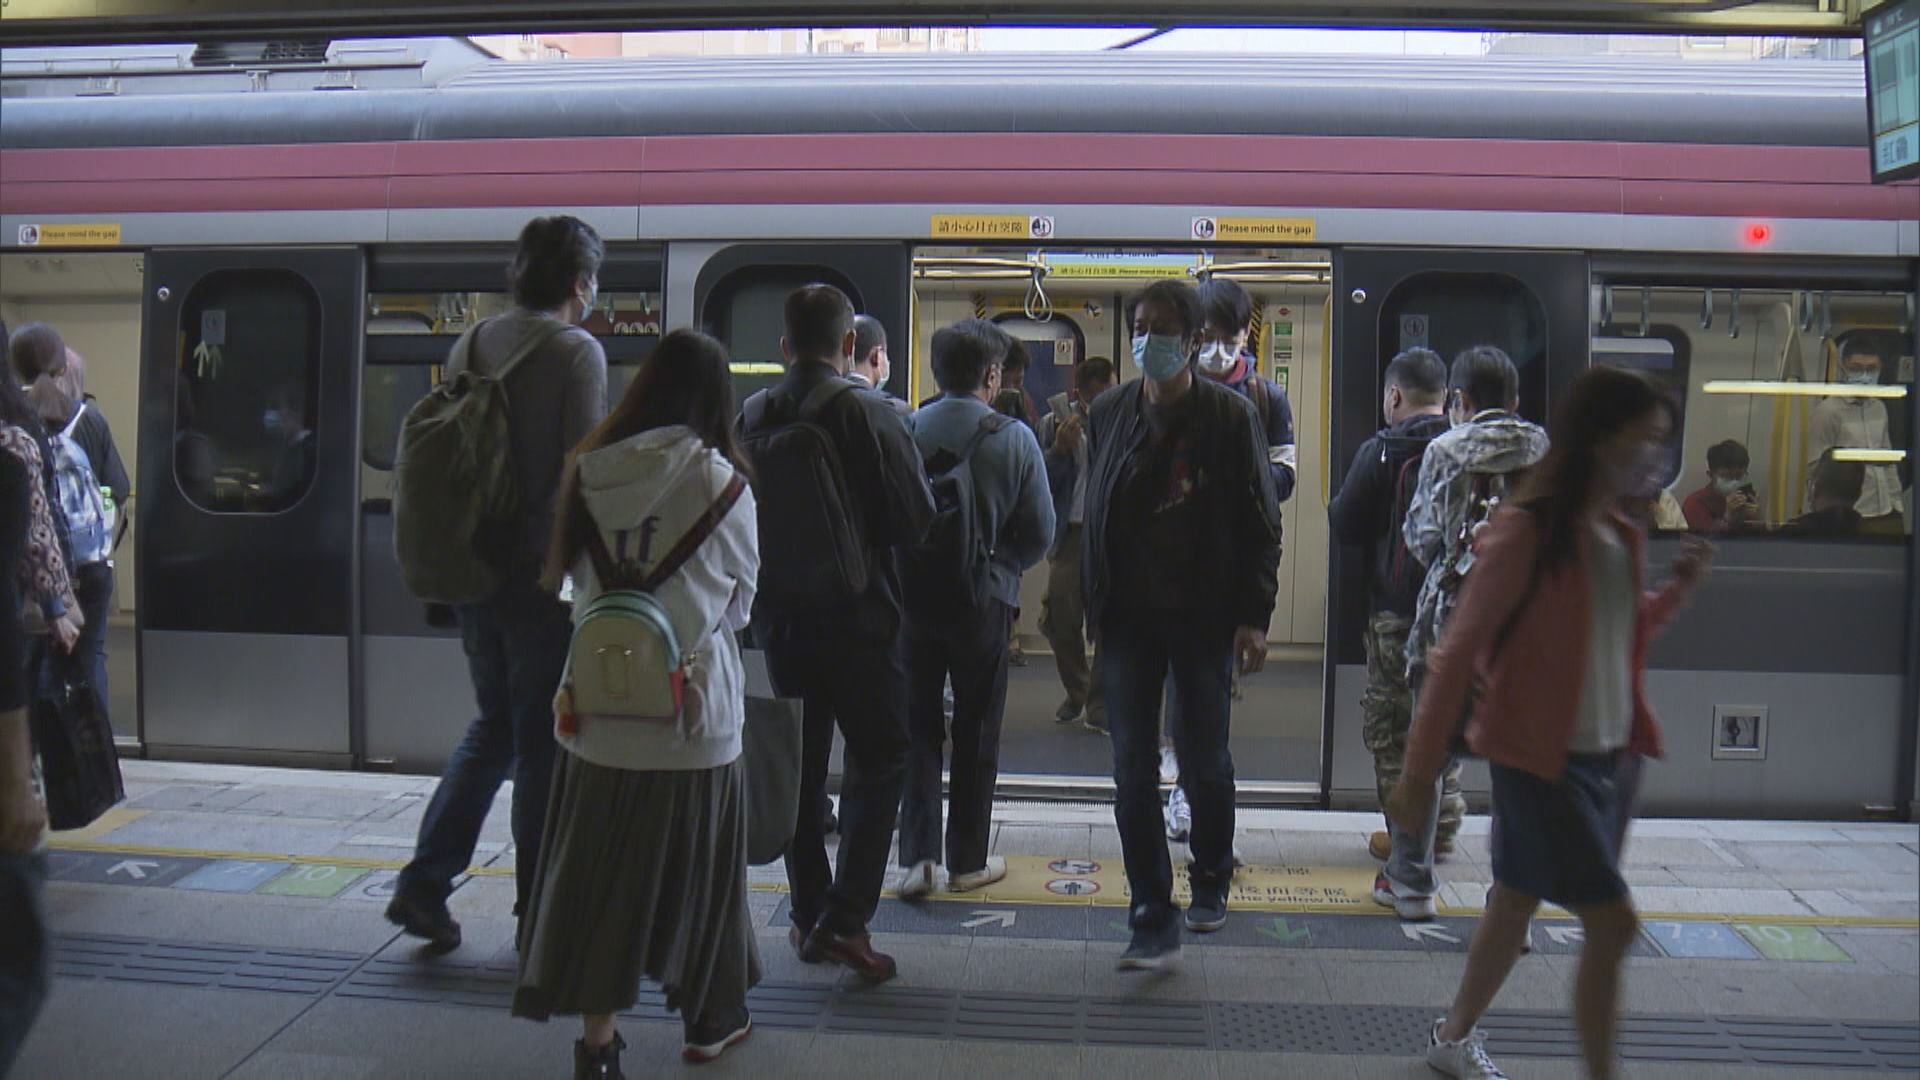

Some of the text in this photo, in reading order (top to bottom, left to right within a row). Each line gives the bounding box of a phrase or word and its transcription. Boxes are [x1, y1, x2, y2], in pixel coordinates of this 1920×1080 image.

[1220, 223, 1312, 236] Please mind the gap
